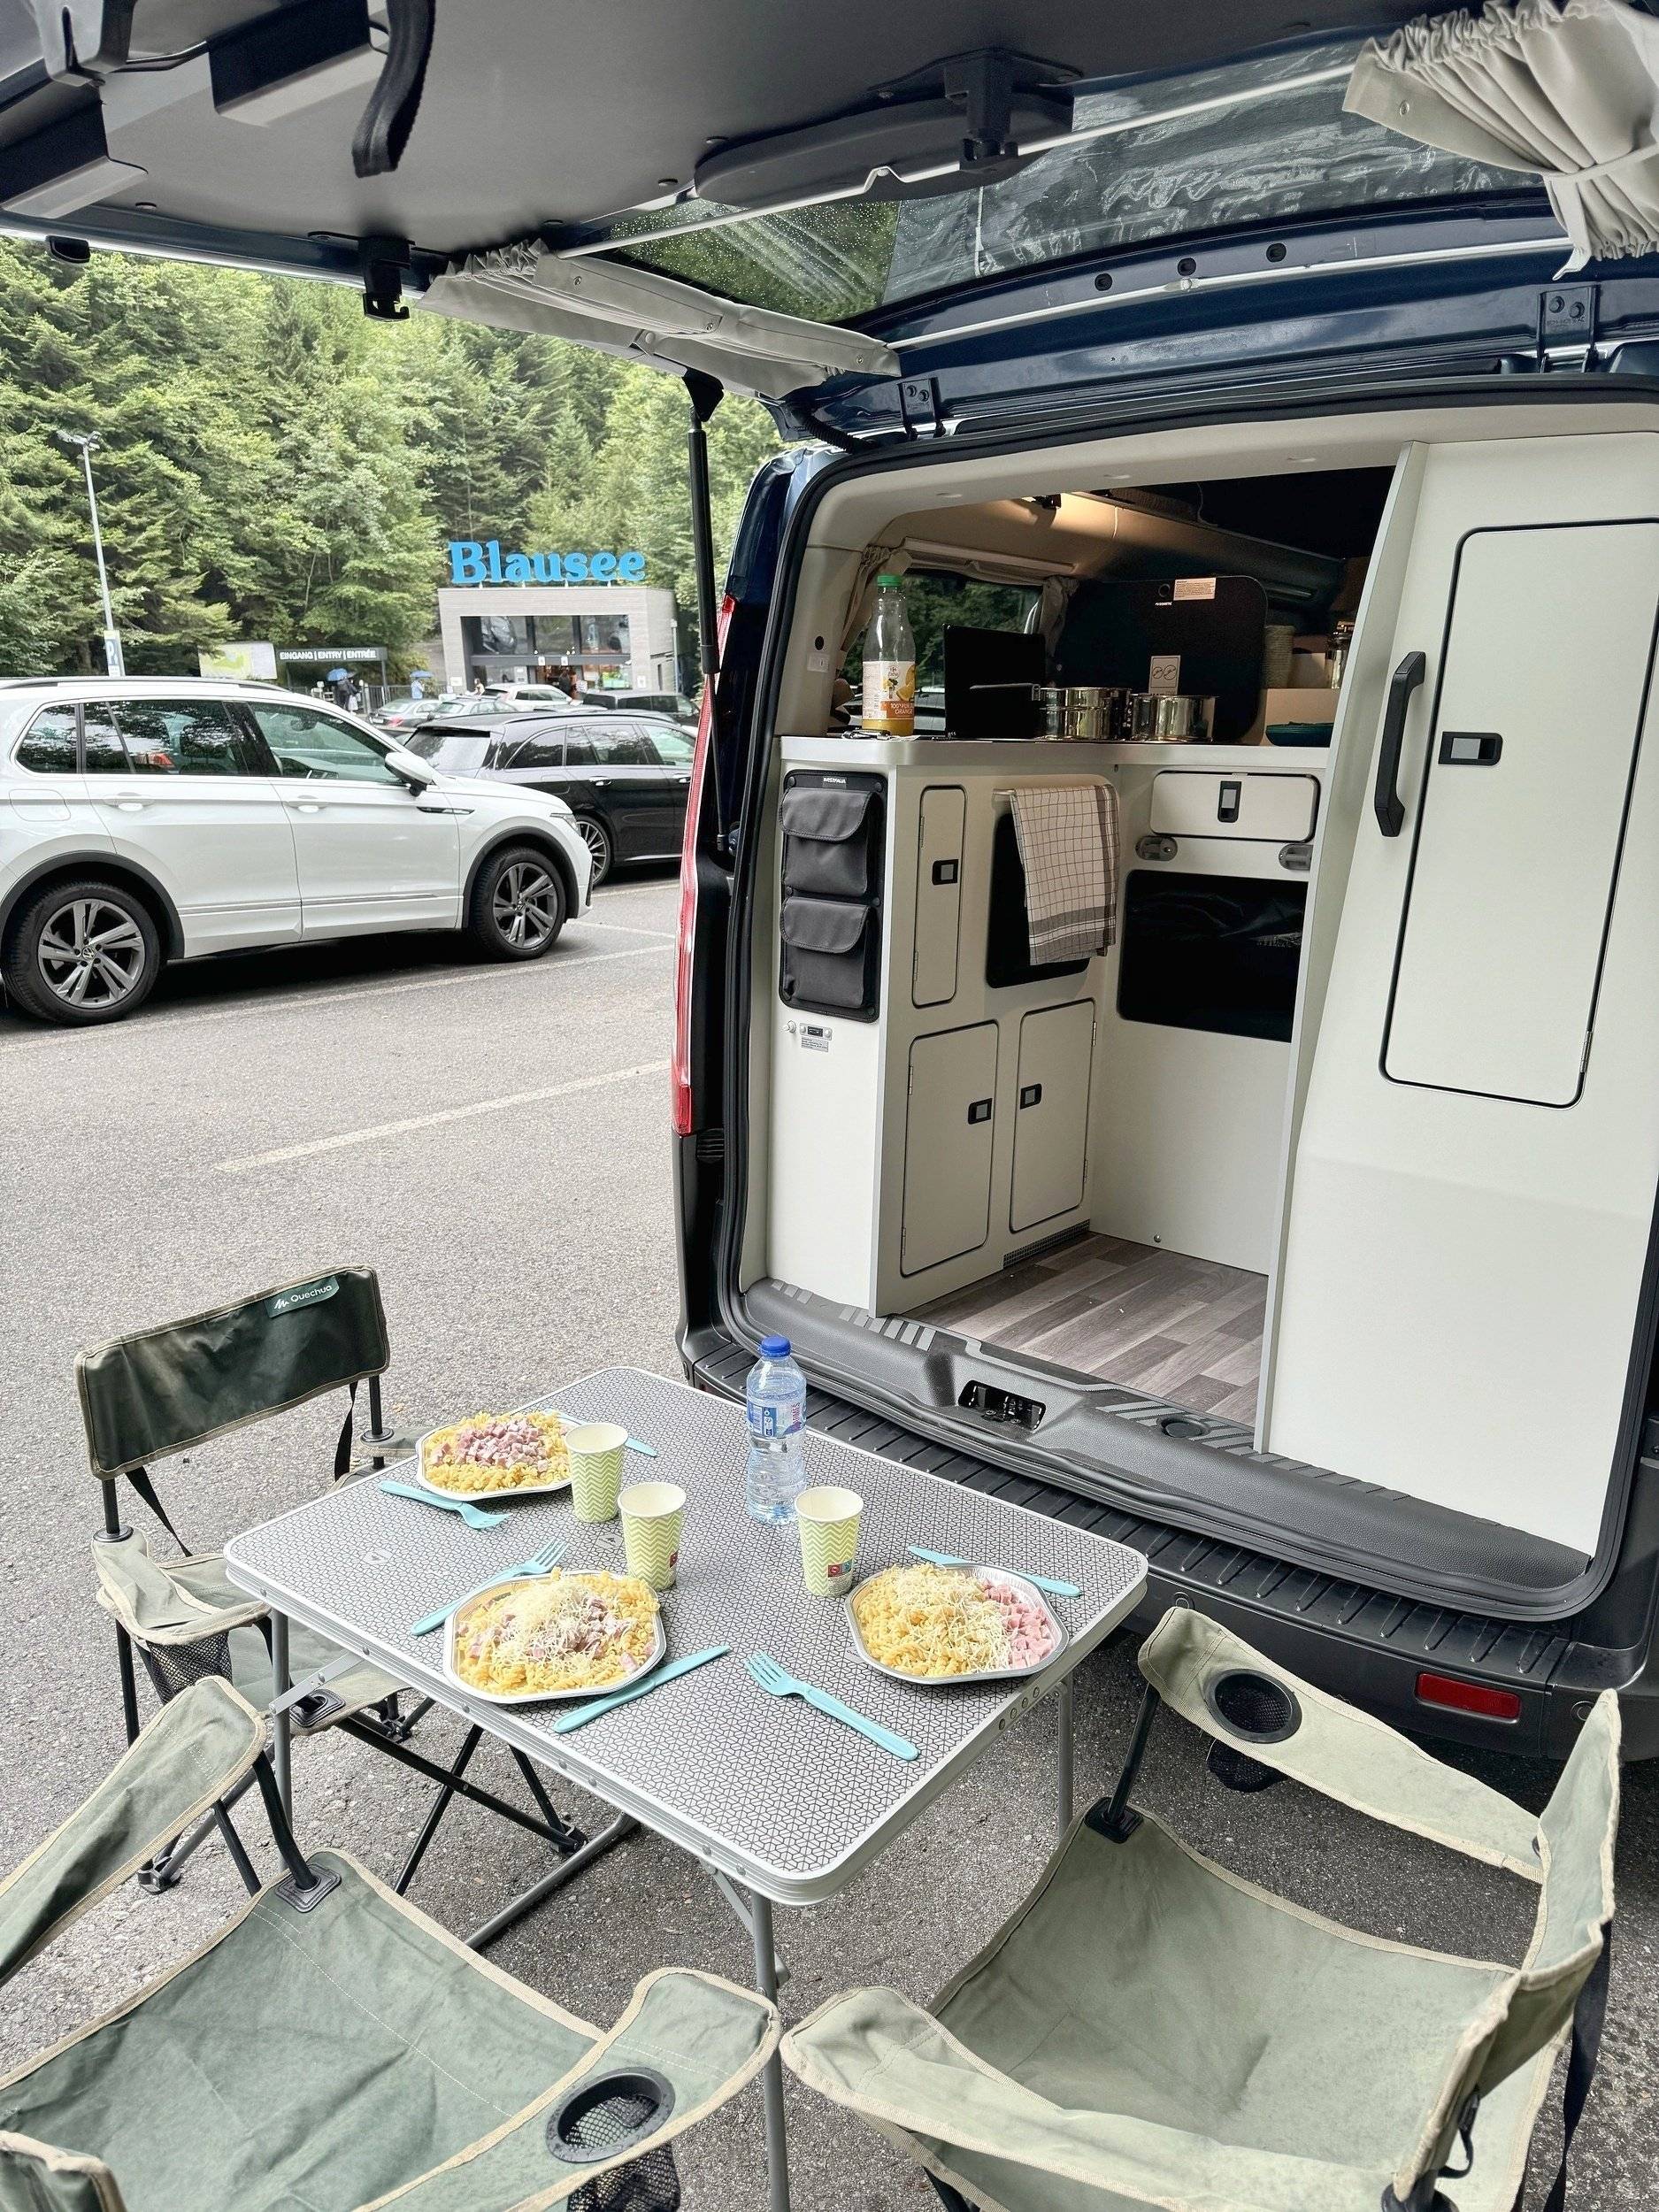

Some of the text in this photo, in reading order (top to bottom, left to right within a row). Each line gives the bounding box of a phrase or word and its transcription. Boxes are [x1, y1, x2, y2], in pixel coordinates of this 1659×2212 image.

[449, 540, 646, 583] Blausee
[280, 649, 376, 660] EINGANG ENTRY ENTRÉE
[290, 1285, 333, 1302] Quechua
